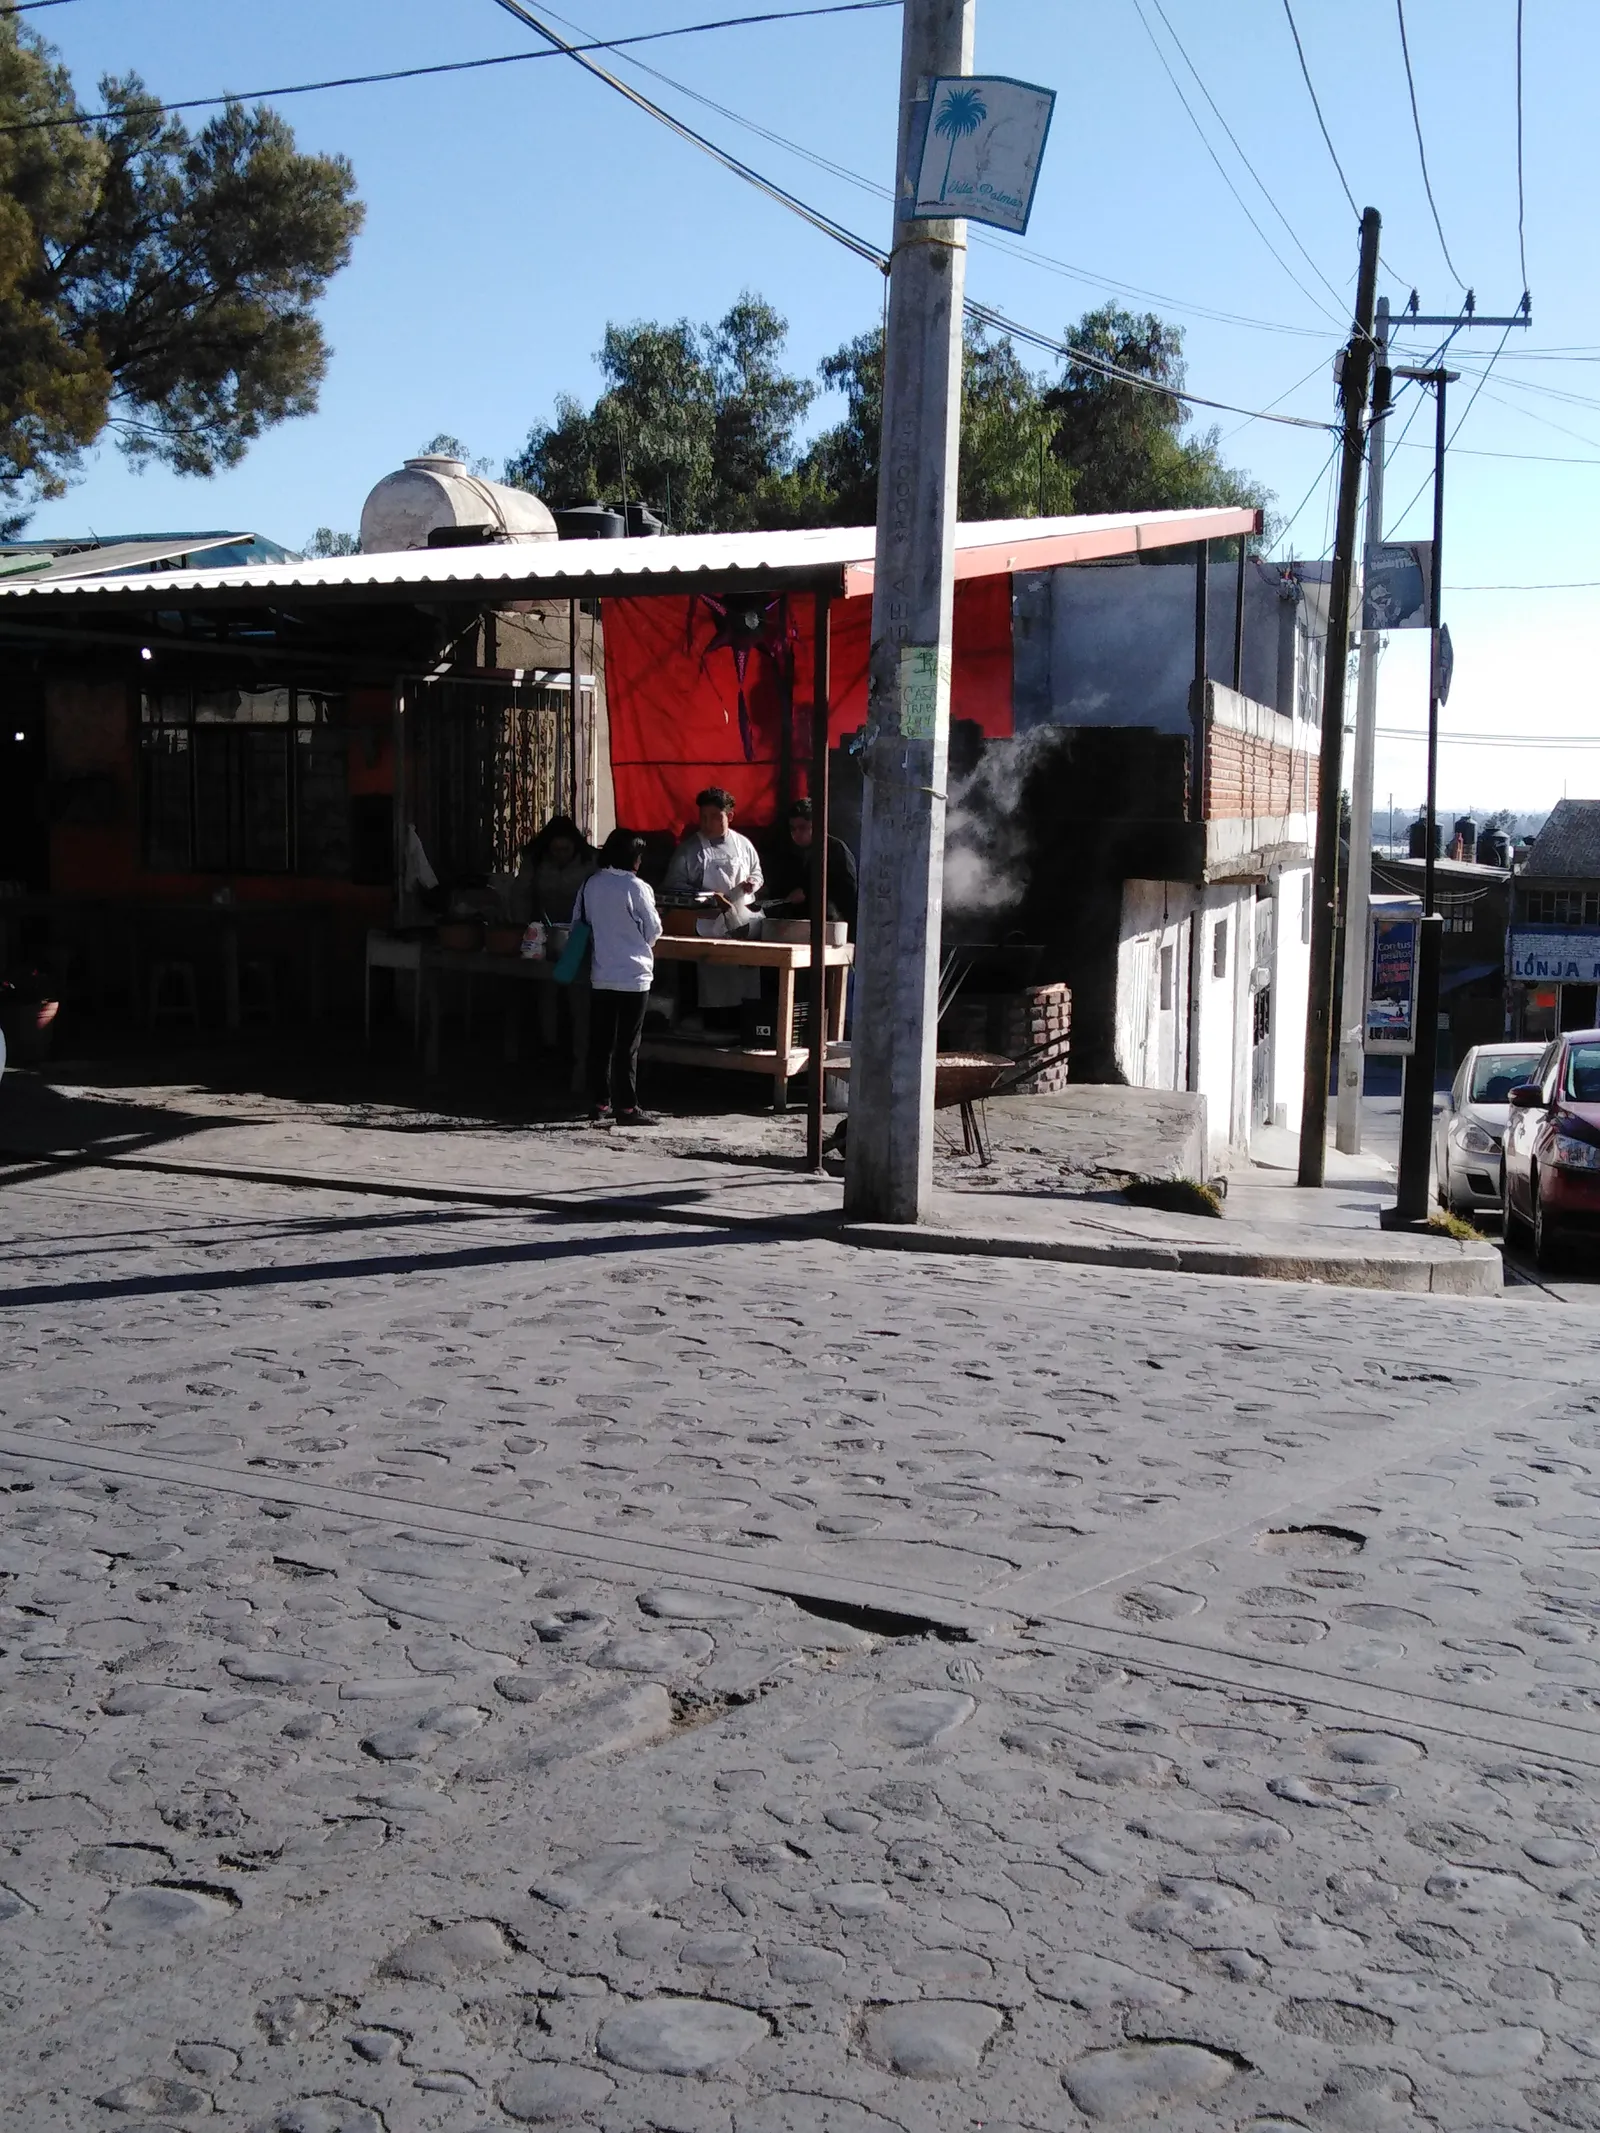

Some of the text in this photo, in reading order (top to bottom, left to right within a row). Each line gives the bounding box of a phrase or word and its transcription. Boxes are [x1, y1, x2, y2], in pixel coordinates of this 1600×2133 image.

[947, 180, 974, 194] Villa
[979, 183, 1024, 209] Palmas
[1378, 941, 1411, 952] Con tus
